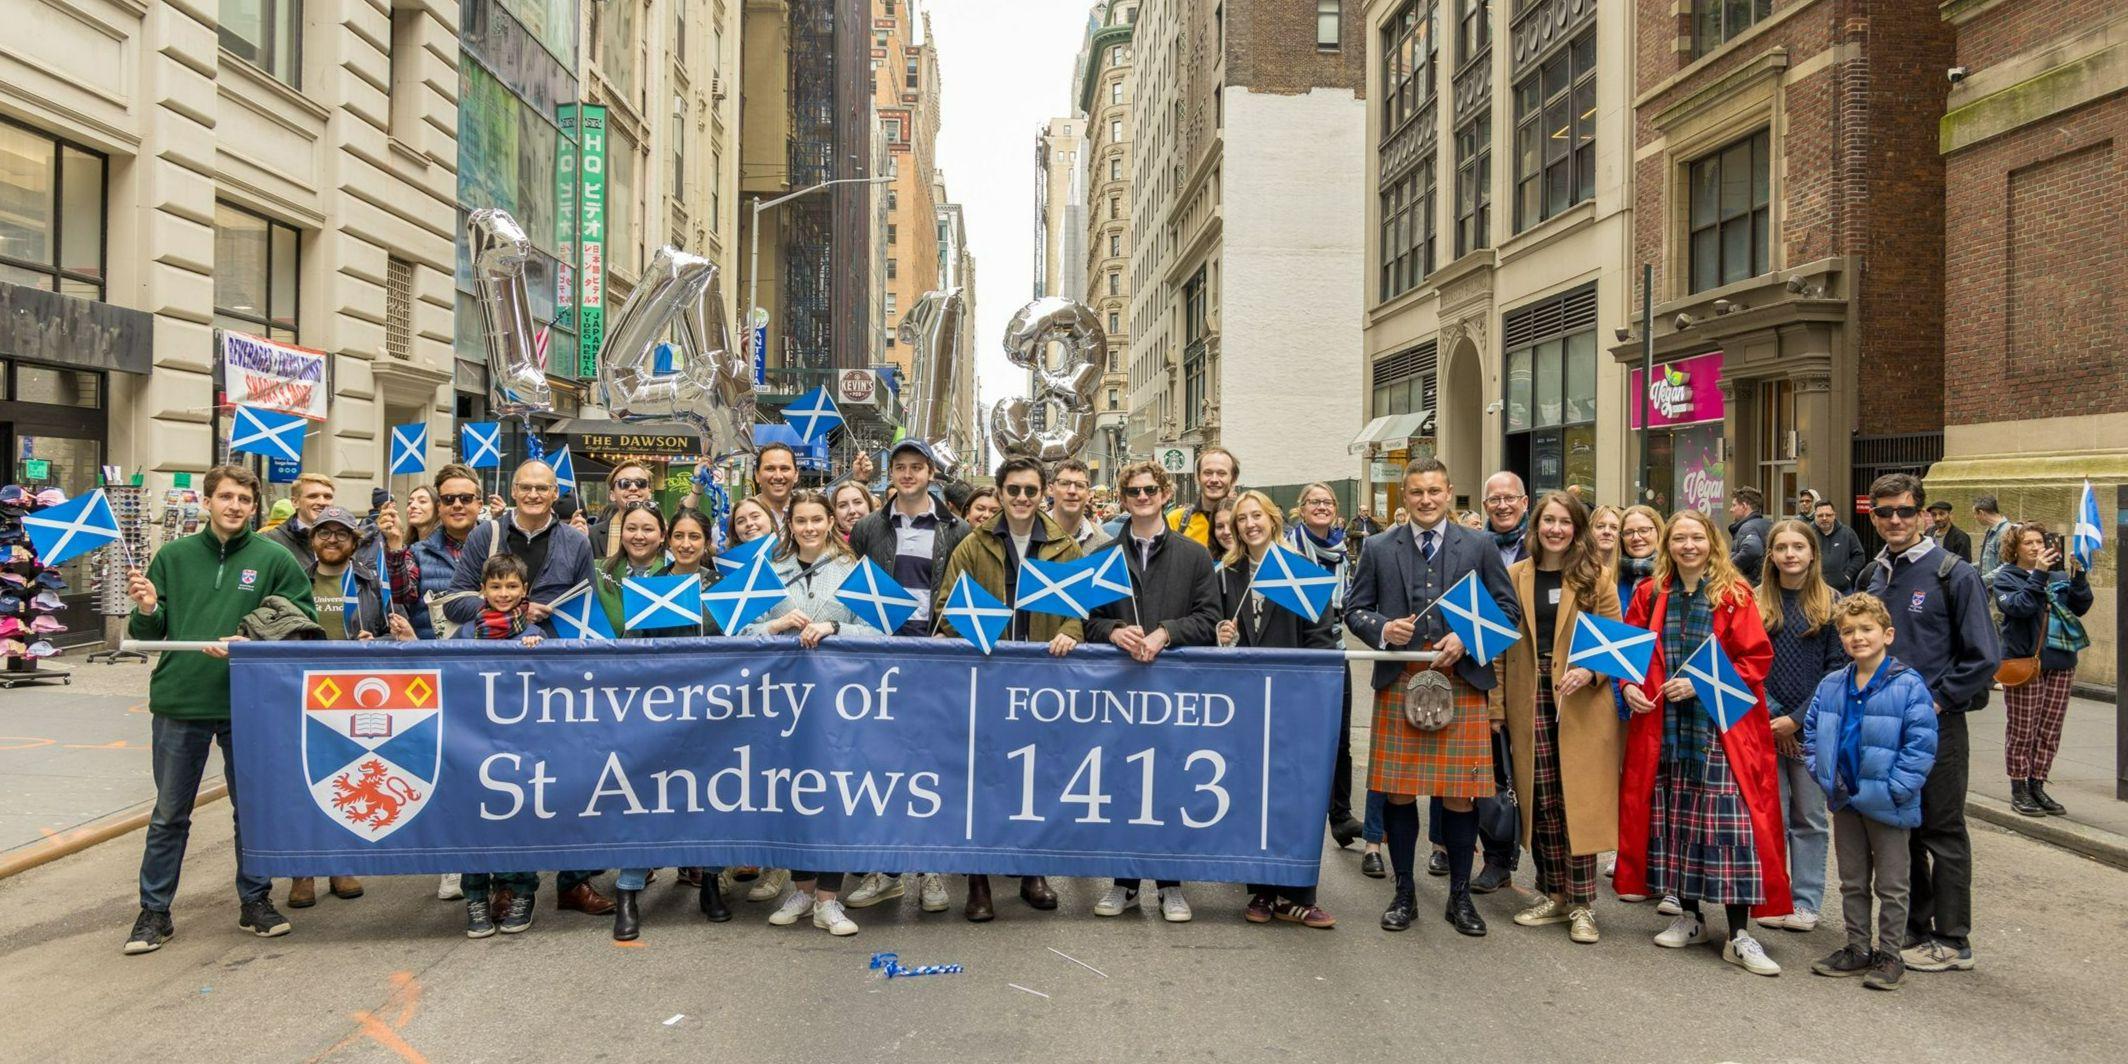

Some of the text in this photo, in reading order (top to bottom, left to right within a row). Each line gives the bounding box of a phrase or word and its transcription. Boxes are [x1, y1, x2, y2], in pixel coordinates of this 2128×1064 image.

[584, 134, 602, 174] HQ
[584, 244, 592, 304] レンタル
[228, 336, 273, 374] BEVERAGES
[583, 311, 592, 376] VIDEO RENTAL
[841, 380, 873, 391] KEVIN'S
[1649, 379, 1686, 418] Vegan
[582, 434, 688, 448] THE DAWSON
[479, 662, 899, 738] University of
[1005, 686, 1235, 727] FOUNDED
[479, 744, 942, 821] St Andrews
[1007, 743, 1230, 829] 1413
